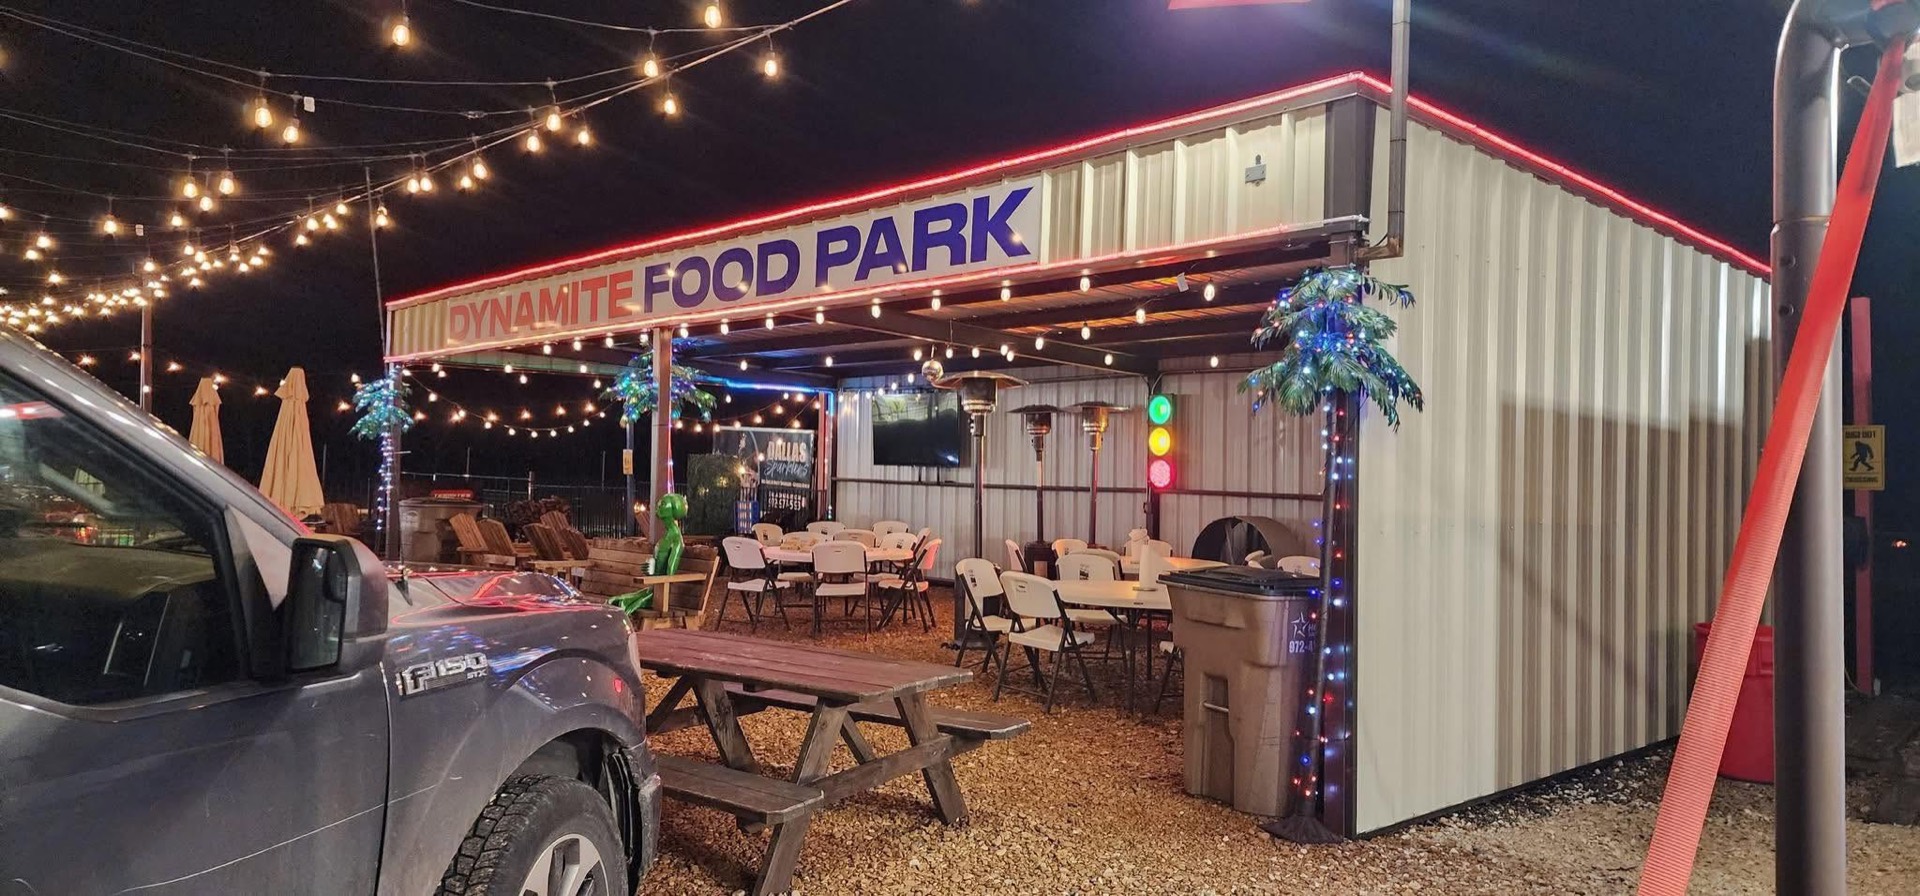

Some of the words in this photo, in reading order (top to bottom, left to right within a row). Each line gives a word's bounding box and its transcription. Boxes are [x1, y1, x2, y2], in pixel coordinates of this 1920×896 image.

[449, 271, 633, 342] DYNAMITE
[644, 239, 801, 313] FOOD
[815, 186, 1033, 288] PARK
[767, 441, 807, 462] DALLAS
[764, 460, 809, 478] Sparklers
[466, 670, 488, 679] STX
